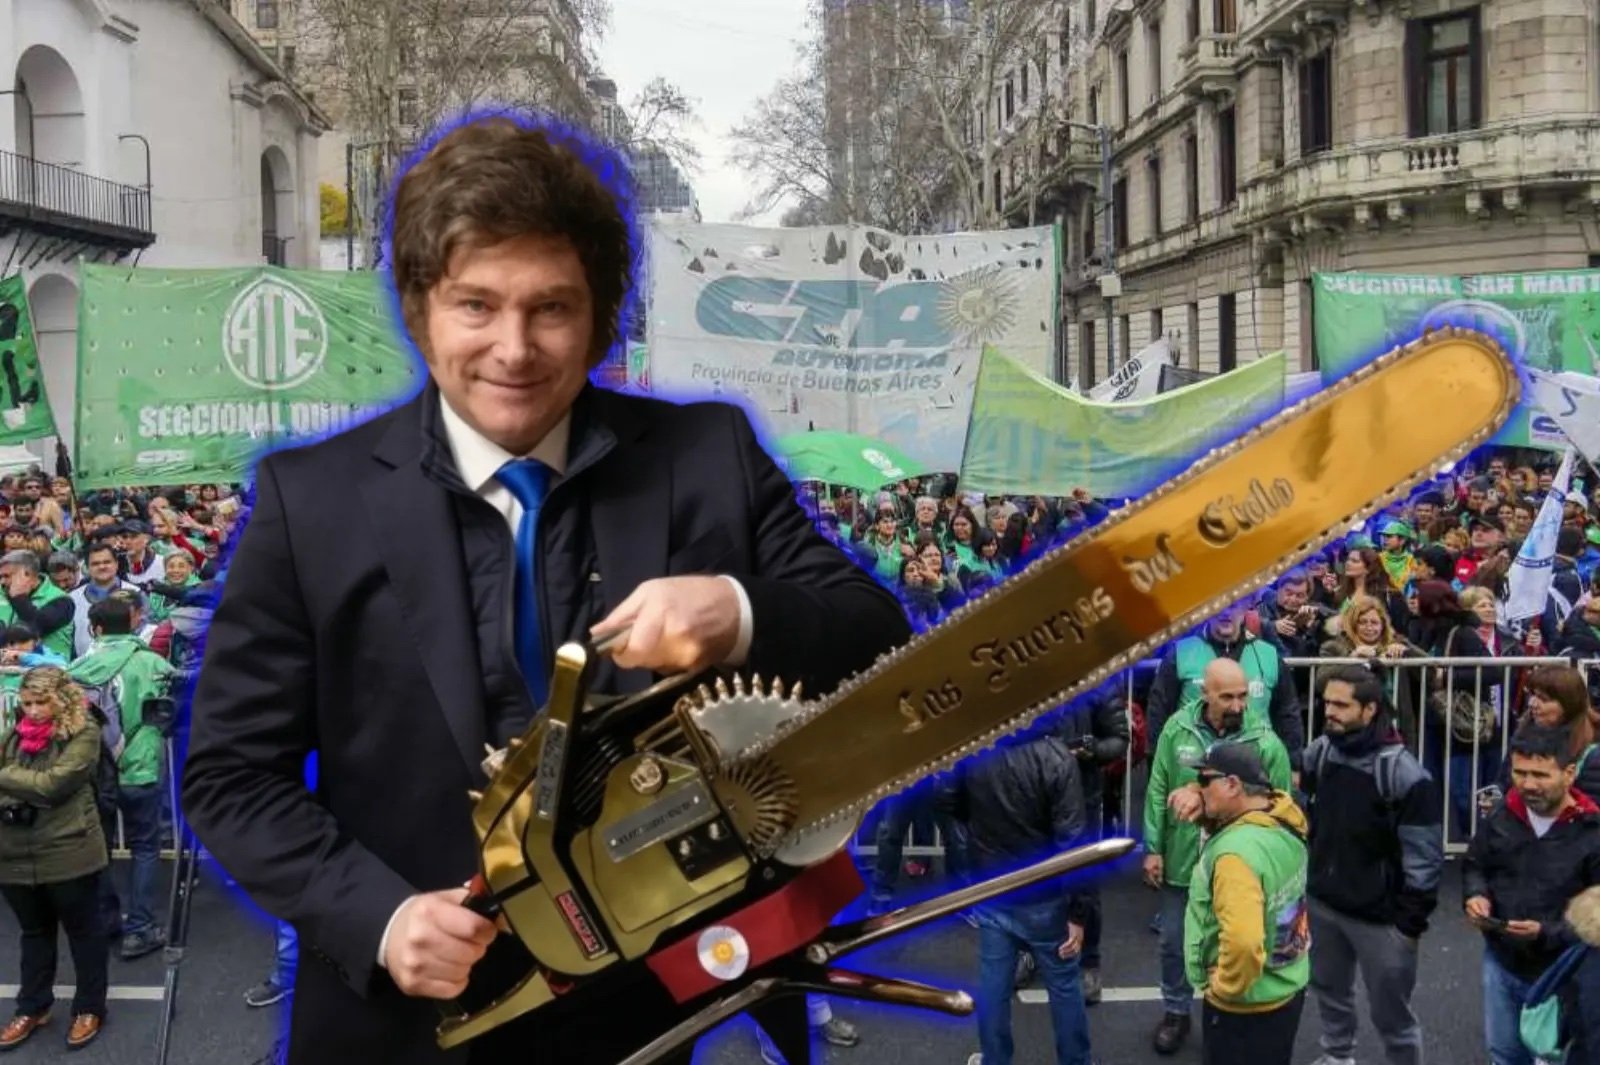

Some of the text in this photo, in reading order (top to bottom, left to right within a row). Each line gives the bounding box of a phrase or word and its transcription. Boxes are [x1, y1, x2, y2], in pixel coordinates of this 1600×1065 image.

[1462, 277, 1514, 295] SAN
[230, 283, 321, 379] ATE
[691, 362, 943, 393] Provincia de Buenos Aires
[138, 401, 285, 438] SECCIONAL
